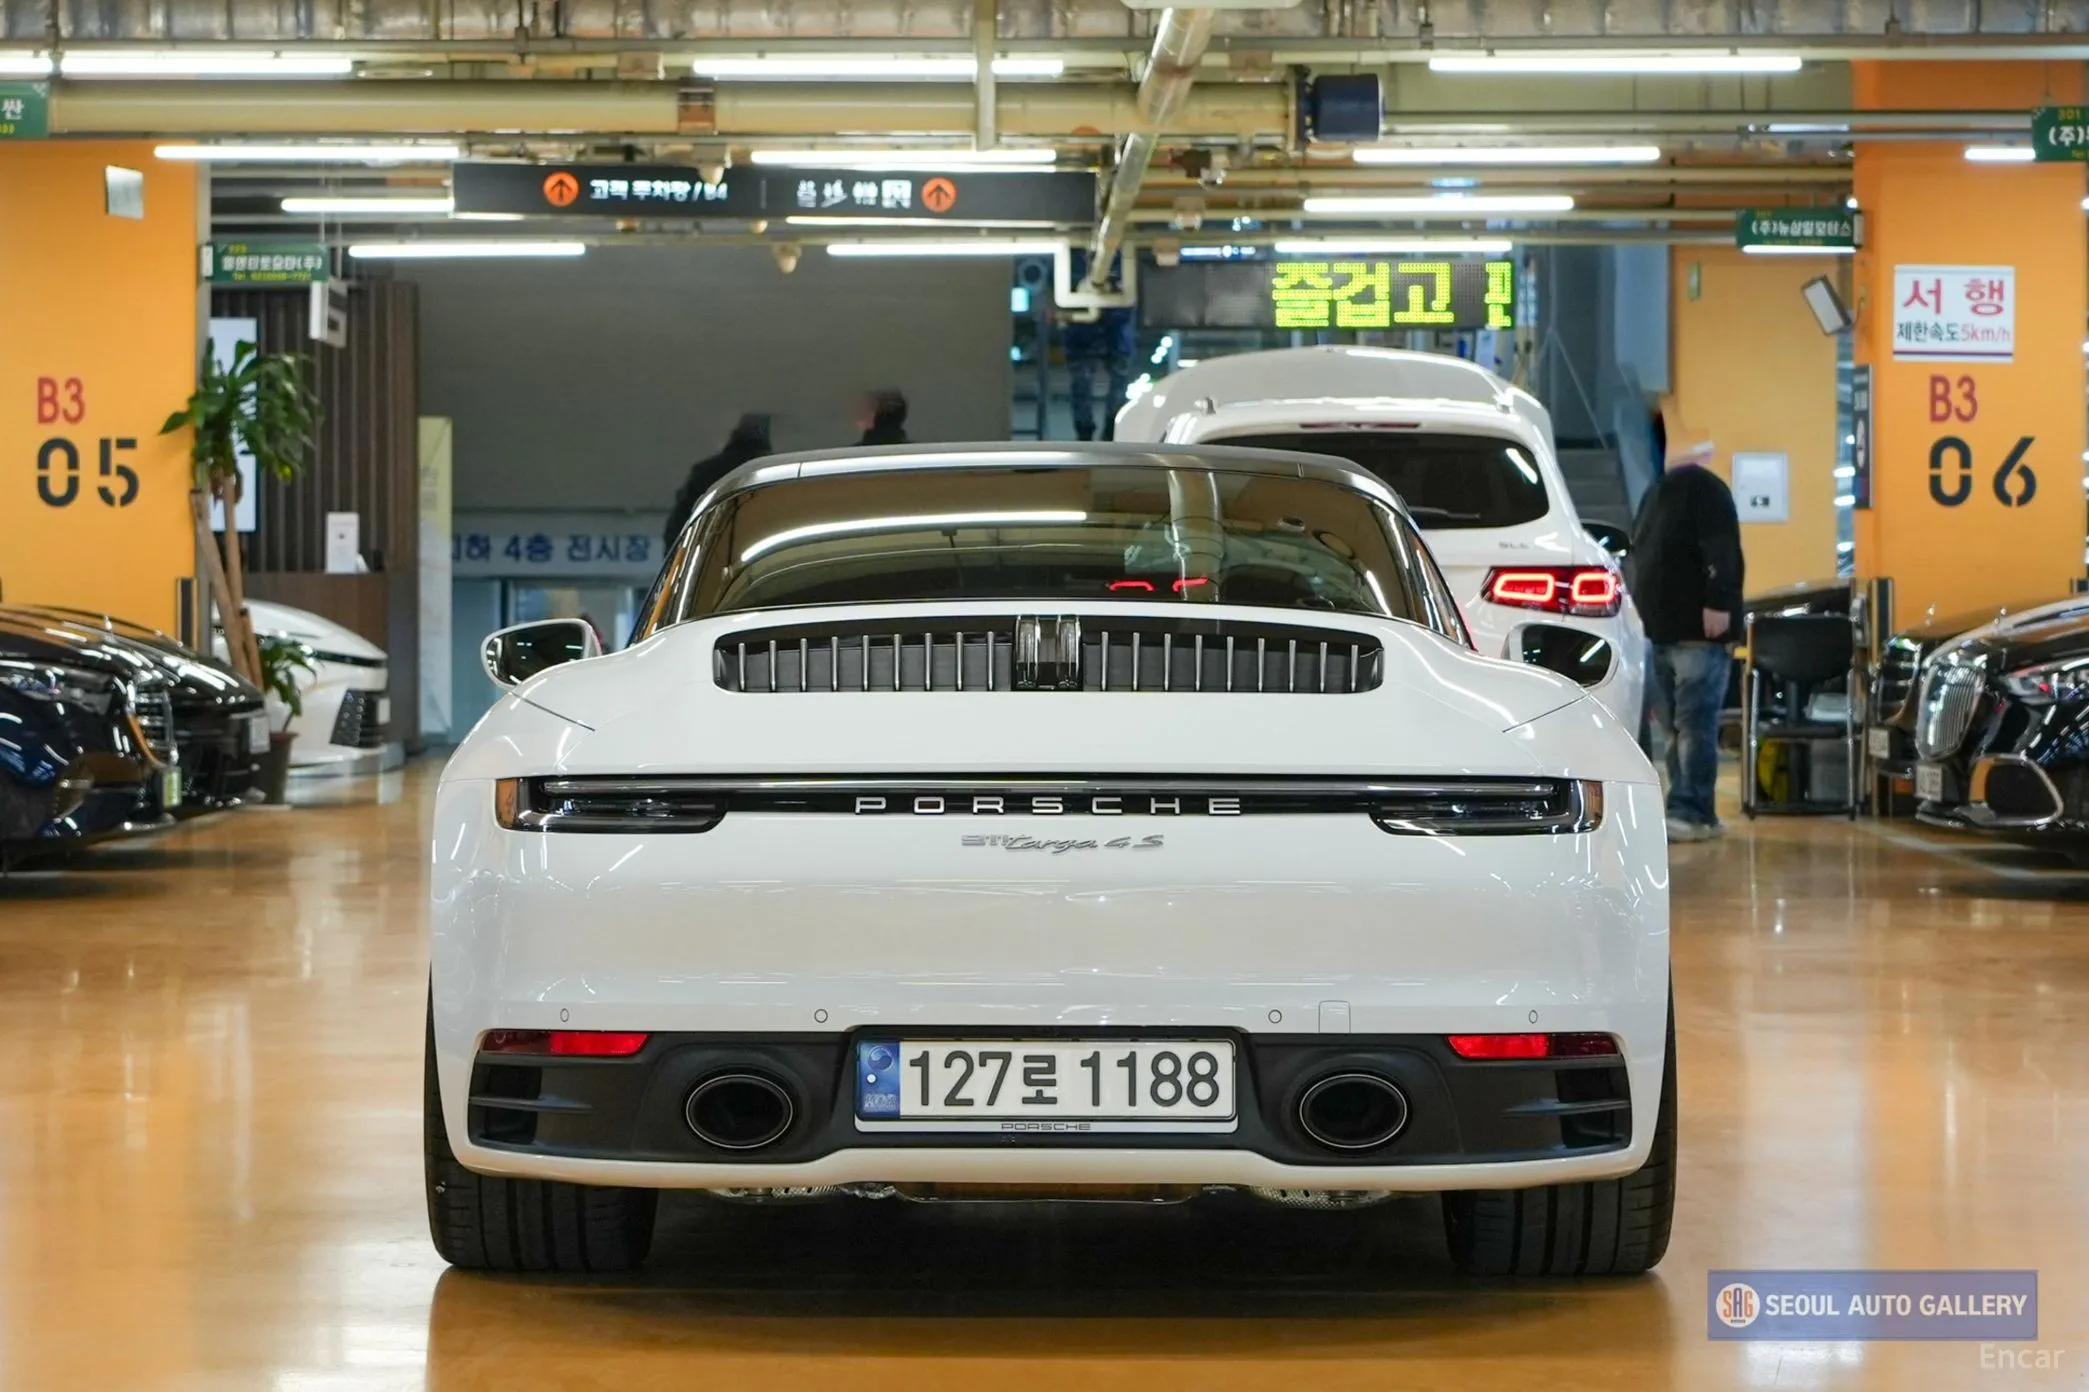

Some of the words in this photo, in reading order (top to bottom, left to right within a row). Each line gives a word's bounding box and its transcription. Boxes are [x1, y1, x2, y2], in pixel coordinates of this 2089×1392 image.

[2048, 126, 2089, 147] (주)
[1272, 261, 1455, 327] 즐겁고
[37, 377, 85, 425] B3
[1929, 374, 1978, 423] B3
[37, 437, 140, 508] 05
[1928, 435, 2037, 508] 06
[503, 534, 554, 564] 4층
[567, 534, 652, 563] 전시장
[854, 796, 1243, 815] PORSCHE
[909, 1050, 1058, 1107] 127로
[1080, 1050, 1220, 1107] 1188
[1001, 1123, 1092, 1131] PORSCHE
